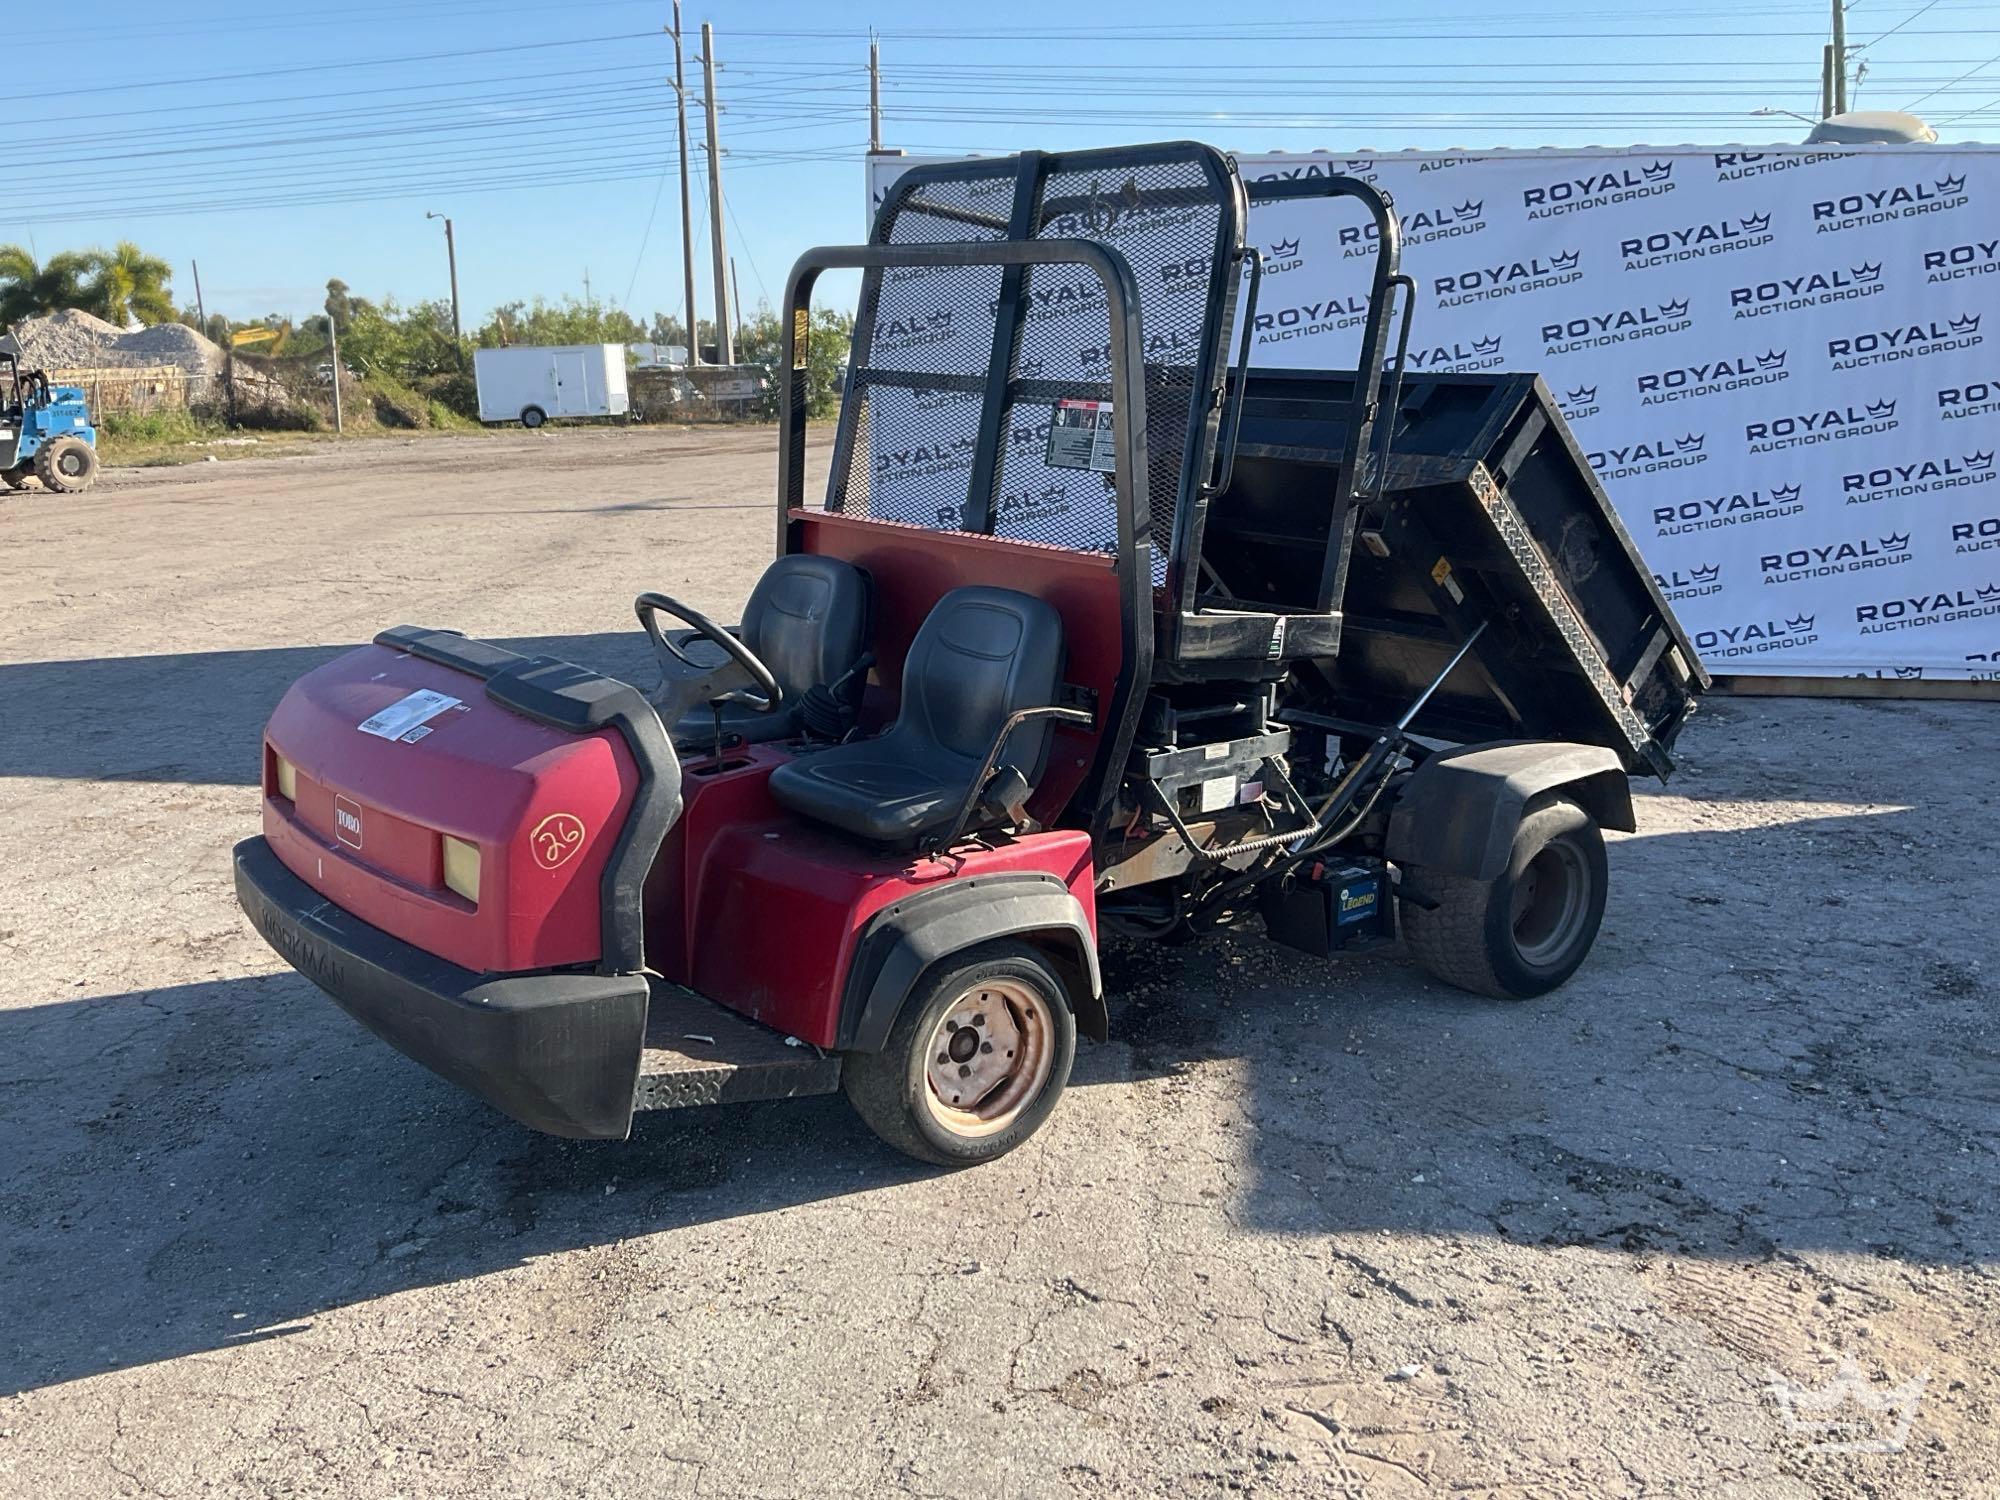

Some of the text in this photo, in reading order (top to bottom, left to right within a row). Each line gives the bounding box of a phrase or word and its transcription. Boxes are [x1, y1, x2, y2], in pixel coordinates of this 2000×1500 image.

[1717, 157, 1800, 183] AUCTION
[1523, 170, 1642, 207] ROYAL
[1527, 183, 1675, 220] AUCTION GROUP
[1812, 183, 1935, 220] ROYAL
[1424, 221, 1486, 242] GROUP
[1816, 196, 1969, 234] AUCTION GROUP
[1620, 221, 1740, 258] ROYAL
[1624, 234, 1774, 271] AUCTION GROUP
[1434, 259, 1549, 295] ROYAL
[1730, 270, 1850, 306] ROYAL
[1927, 262, 2000, 284] AUCTIO
[1438, 272, 1583, 309] AUCTION GROUP
[1734, 284, 1884, 320] AUCTION GROUP
[1254, 297, 1365, 332] ROYAL
[1541, 307, 1659, 343] ROYAL
[1258, 321, 1334, 345] AUCTION
[1545, 320, 1692, 356] AUCTION GROUP
[1828, 322, 1948, 357] ROYAL
[1832, 336, 1983, 371] AUCTION GROUP
[1638, 358, 1755, 393] ROYAL
[1641, 371, 1789, 407] AUCTION GROUP
[1563, 406, 1600, 421] OUP
[1746, 407, 1865, 441] ROYAL
[1941, 402, 2000, 420] AUCTI
[1749, 421, 1899, 455] AUCTION GROUP
[1585, 441, 1674, 470] OYAL
[1598, 454, 1707, 481] TION GROUP
[1843, 459, 1962, 492] ROYAL
[1846, 472, 1996, 506] AUCTION GROUP
[1653, 491, 1770, 524] ROYAL
[1656, 504, 1804, 537] AUCTION GROUP
[1760, 540, 1879, 572] ROYAL
[1764, 553, 1912, 585] AUCTION GROUP
[1856, 591, 1975, 622] ROYAL
[1695, 621, 1786, 648] OYAL
[1859, 614, 1940, 636] AUCTION
[1756, 634, 1818, 653] GROUP
[337, 808, 360, 834] TORO
[538, 821, 579, 862] 26
[1342, 893, 1375, 911] LEGEND
[262, 908, 345, 985] WORKMAN
